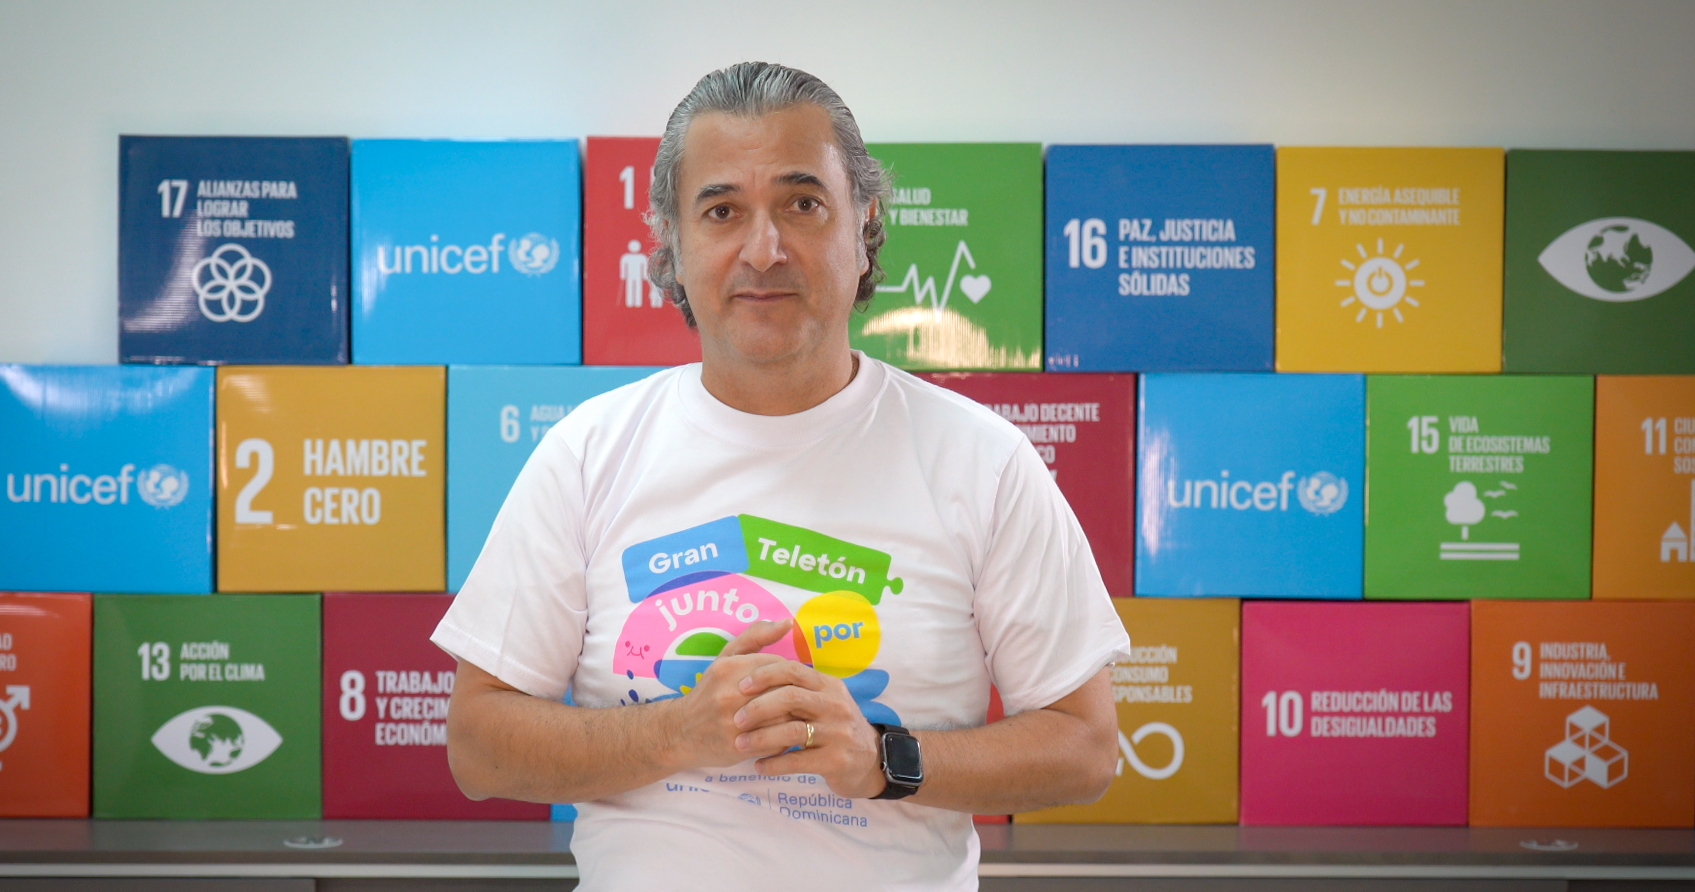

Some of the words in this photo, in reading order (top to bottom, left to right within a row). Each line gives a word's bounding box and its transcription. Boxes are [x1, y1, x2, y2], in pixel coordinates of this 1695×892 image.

[158, 179, 189, 218] 17
[197, 180, 260, 198] ALIANZAS
[261, 181, 298, 199] PARA
[618, 165, 636, 210] 1
[1338, 185, 1391, 205] ENERGÍA
[1394, 187, 1460, 206] ASEQUIBLE
[197, 200, 249, 218] LOGRAR
[888, 208, 898, 226] Y
[899, 207, 968, 227] BIENESTAR
[1310, 187, 1328, 226] 7
[1338, 207, 1347, 226] Y
[1348, 207, 1366, 226] NO
[1367, 208, 1460, 226] CONTAMINANTE
[197, 219, 222, 237] LOS
[223, 220, 296, 239] OBJETIVOS
[1118, 218, 1157, 243] PAZ,
[1159, 218, 1236, 242] JUSTICIA
[376, 233, 506, 275] unicef
[1063, 218, 1108, 269] 16
[1118, 246, 1129, 269] E
[1131, 246, 1256, 269] INSTITUCIONES
[1118, 270, 1191, 296] SÓLIDAS
[500, 404, 520, 443] 6
[984, 403, 1039, 422] ABAJO
[1040, 402, 1100, 422] DECENTE
[1449, 415, 1479, 433] VIDA
[1407, 415, 1440, 454] 15
[1449, 435, 1464, 453] DE
[1465, 436, 1550, 454] ECOSISTEMAS
[1641, 416, 1667, 456] 11
[303, 438, 428, 477] HAMBRE
[1449, 455, 1524, 473] TERRESTRES
[7, 463, 135, 505] unicef
[235, 437, 275, 525] 2
[1167, 469, 1295, 511] unicef
[303, 486, 381, 525] CERO
[649, 542, 718, 574] Gran
[758, 537, 866, 584] Teletón
[655, 588, 774, 632] junto
[813, 620, 864, 648] por
[137, 642, 171, 681] 13
[180, 640, 229, 660] ACCIÓN
[1122, 643, 1177, 664] UCCIÓN
[1512, 641, 1532, 680] 9
[1540, 642, 1611, 660] INDUSTRIA,
[180, 663, 207, 681] POR
[208, 663, 223, 681] EL
[224, 663, 266, 681] CLIMA
[375, 670, 456, 694] TRABAJO
[1540, 660, 1616, 680] INNOVACIÓN
[1618, 663, 1626, 680] E
[339, 670, 366, 721] 8
[1112, 685, 1193, 703] SPONSABLES
[1311, 688, 1399, 712] REDUCCIÓN
[1401, 692, 1421, 712] DE
[1424, 691, 1452, 712] LAS
[1539, 681, 1659, 700] INFRAESTRUCTURA
[375, 697, 388, 719] Y
[389, 697, 450, 720] CRECIM
[1262, 690, 1304, 737] 10
[375, 719, 447, 746] ECONÓM
[1311, 716, 1436, 737] DESIGUALDADES
[705, 775, 713, 783] a
[797, 775, 816, 784] de
[777, 792, 853, 809] República
[779, 806, 868, 827] Dominicana
